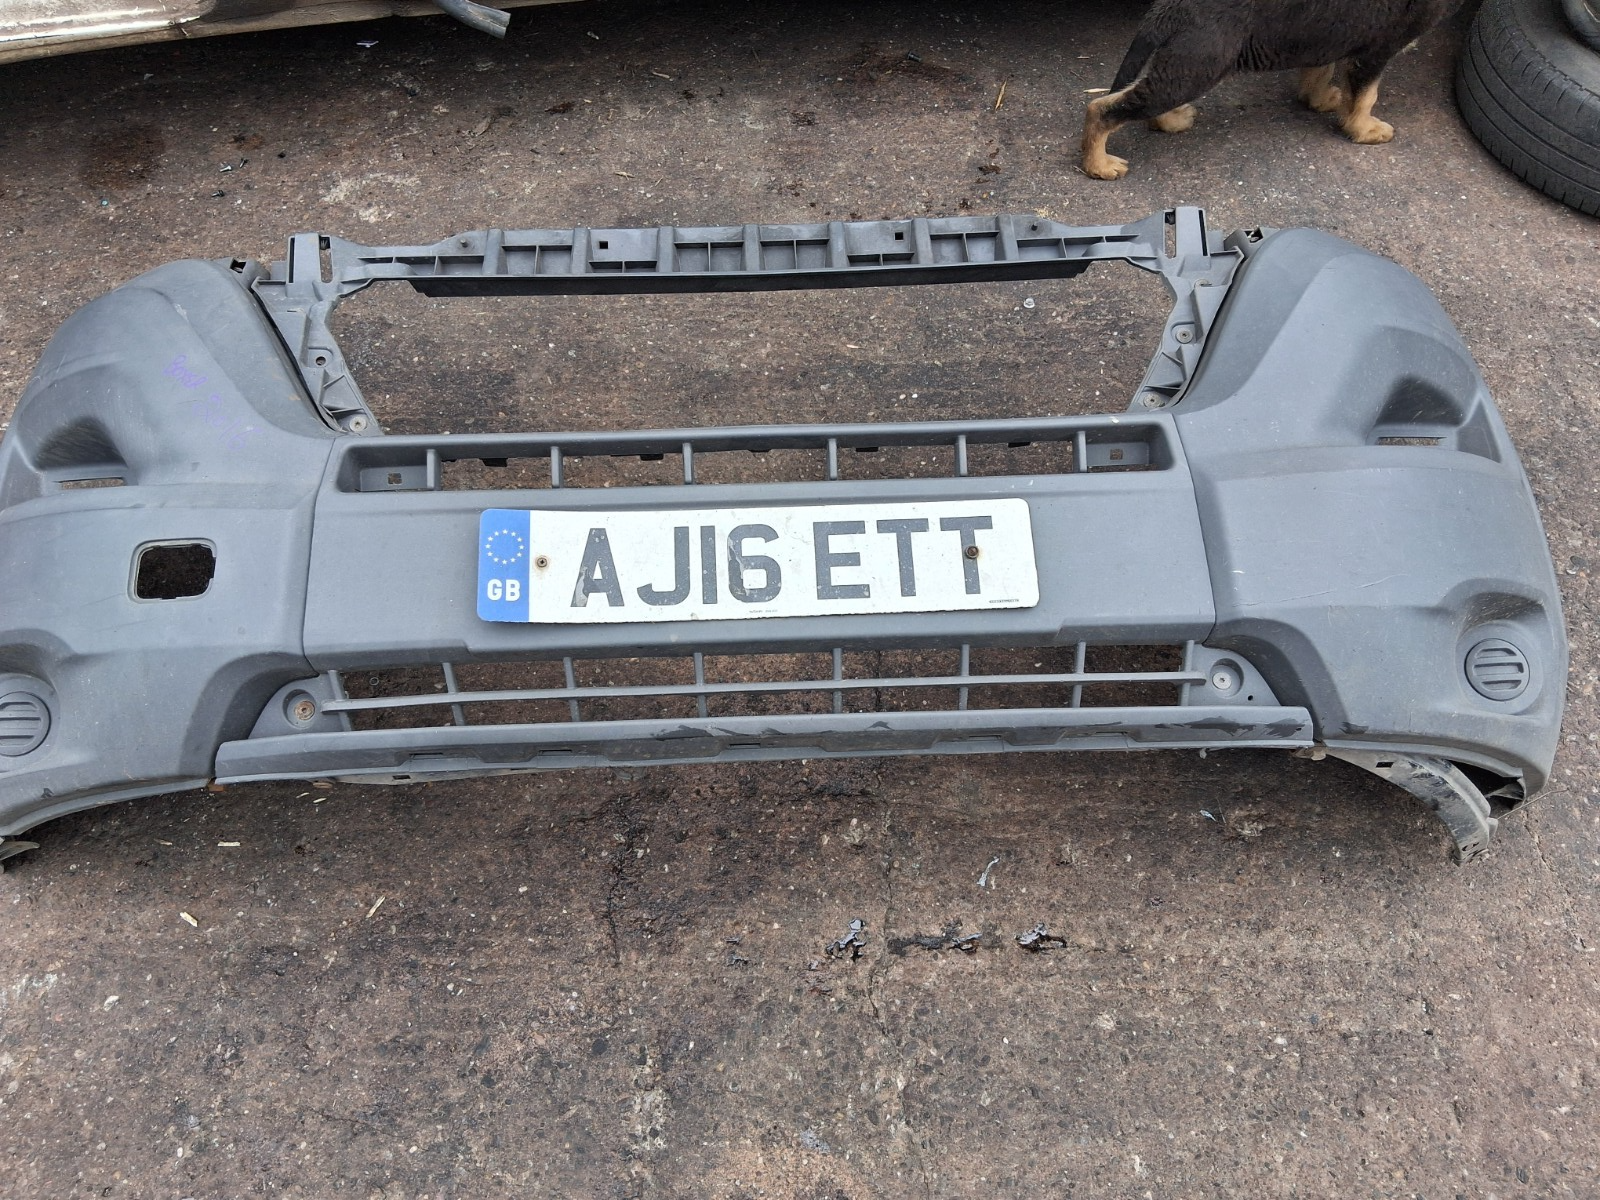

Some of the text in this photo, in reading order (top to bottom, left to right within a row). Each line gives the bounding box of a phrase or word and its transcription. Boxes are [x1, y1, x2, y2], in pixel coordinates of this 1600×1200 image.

[487, 578, 520, 601] GB
[569, 516, 993, 608] AJ16 ETT
